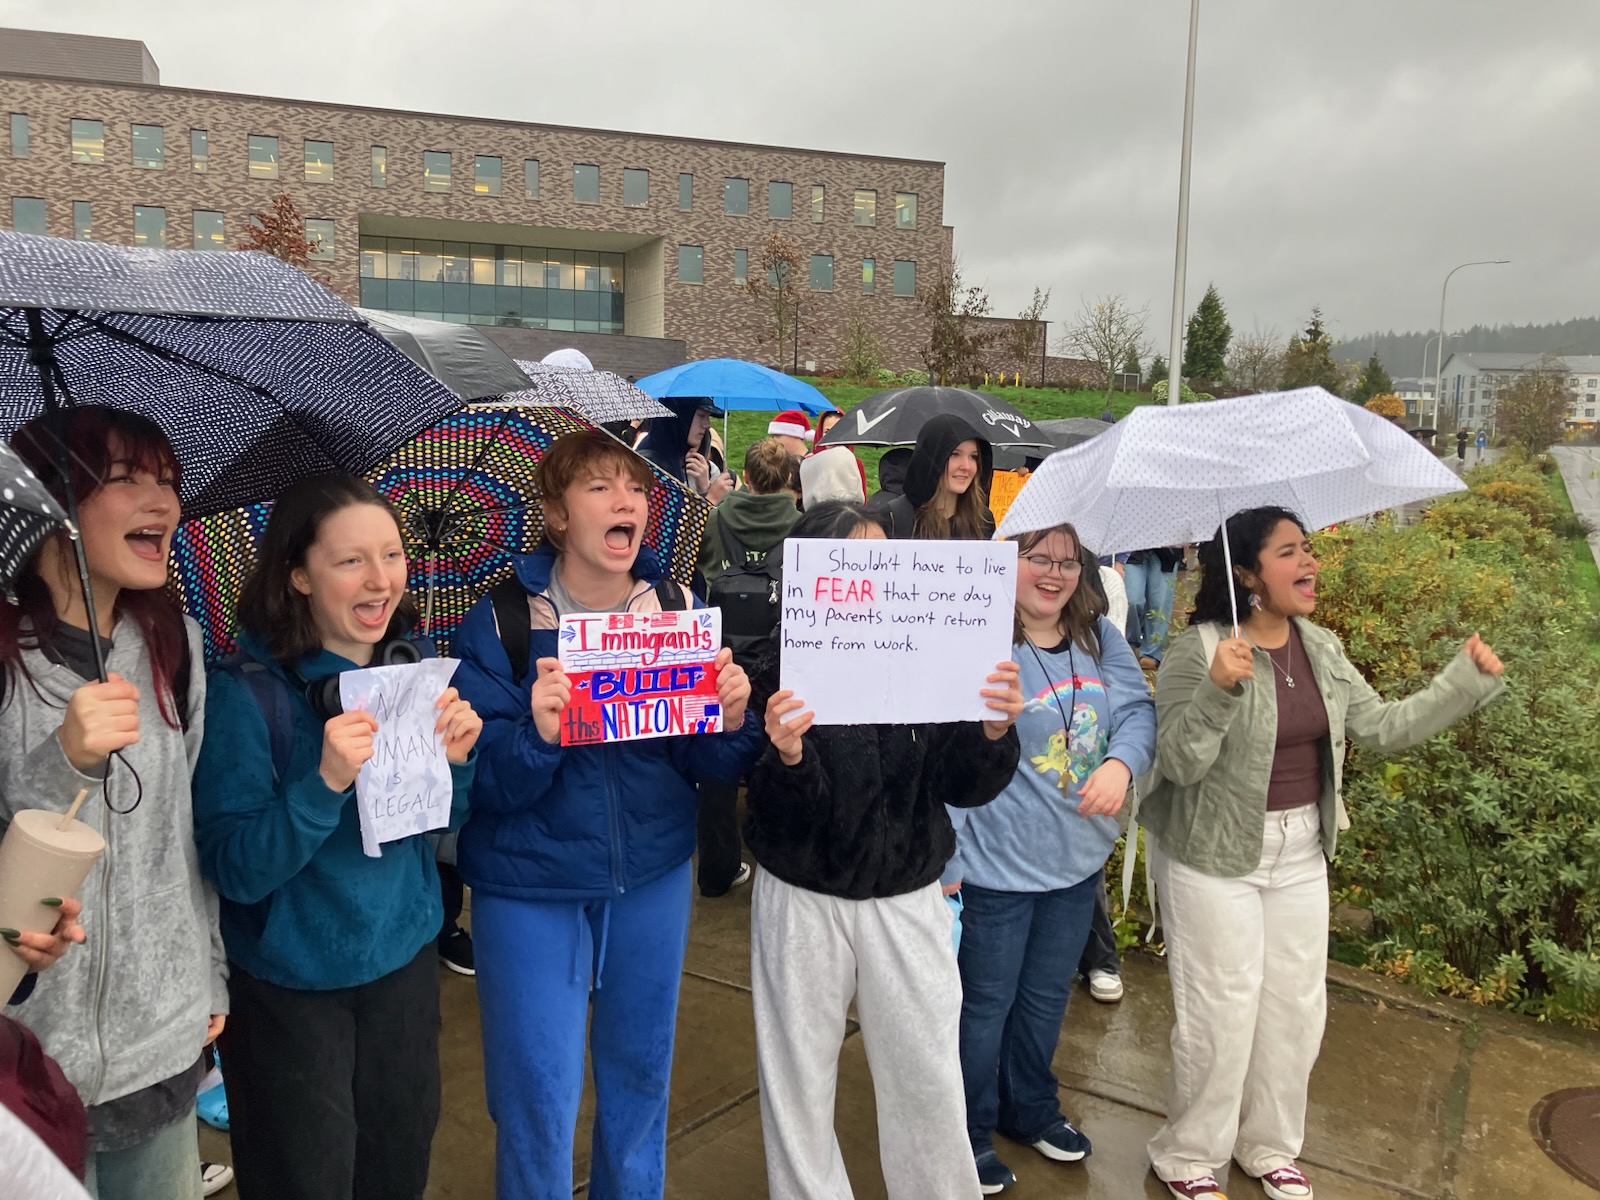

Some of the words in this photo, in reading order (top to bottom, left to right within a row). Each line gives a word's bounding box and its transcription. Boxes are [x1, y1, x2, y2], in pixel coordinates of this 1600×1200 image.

[829, 548, 900, 573] Shouldn't
[913, 552, 945, 573] have
[956, 556, 973, 574] to
[984, 558, 1006, 575] live
[787, 581, 803, 598] in
[815, 577, 874, 602] FEAR
[883, 582, 920, 601] that
[928, 591, 956, 601] one
[963, 586, 991, 607] day
[785, 607, 816, 627] my
[891, 612, 935, 625] won't
[945, 613, 987, 627] return
[566, 618, 712, 666] Immigrants
[785, 629, 822, 649] home
[831, 636, 865, 650] from
[874, 635, 918, 652] work.
[591, 666, 703, 701] BUILT
[373, 682, 412, 721] NO
[564, 706, 600, 739] this
[601, 698, 685, 741] NATION
[369, 728, 437, 768] UMAN
